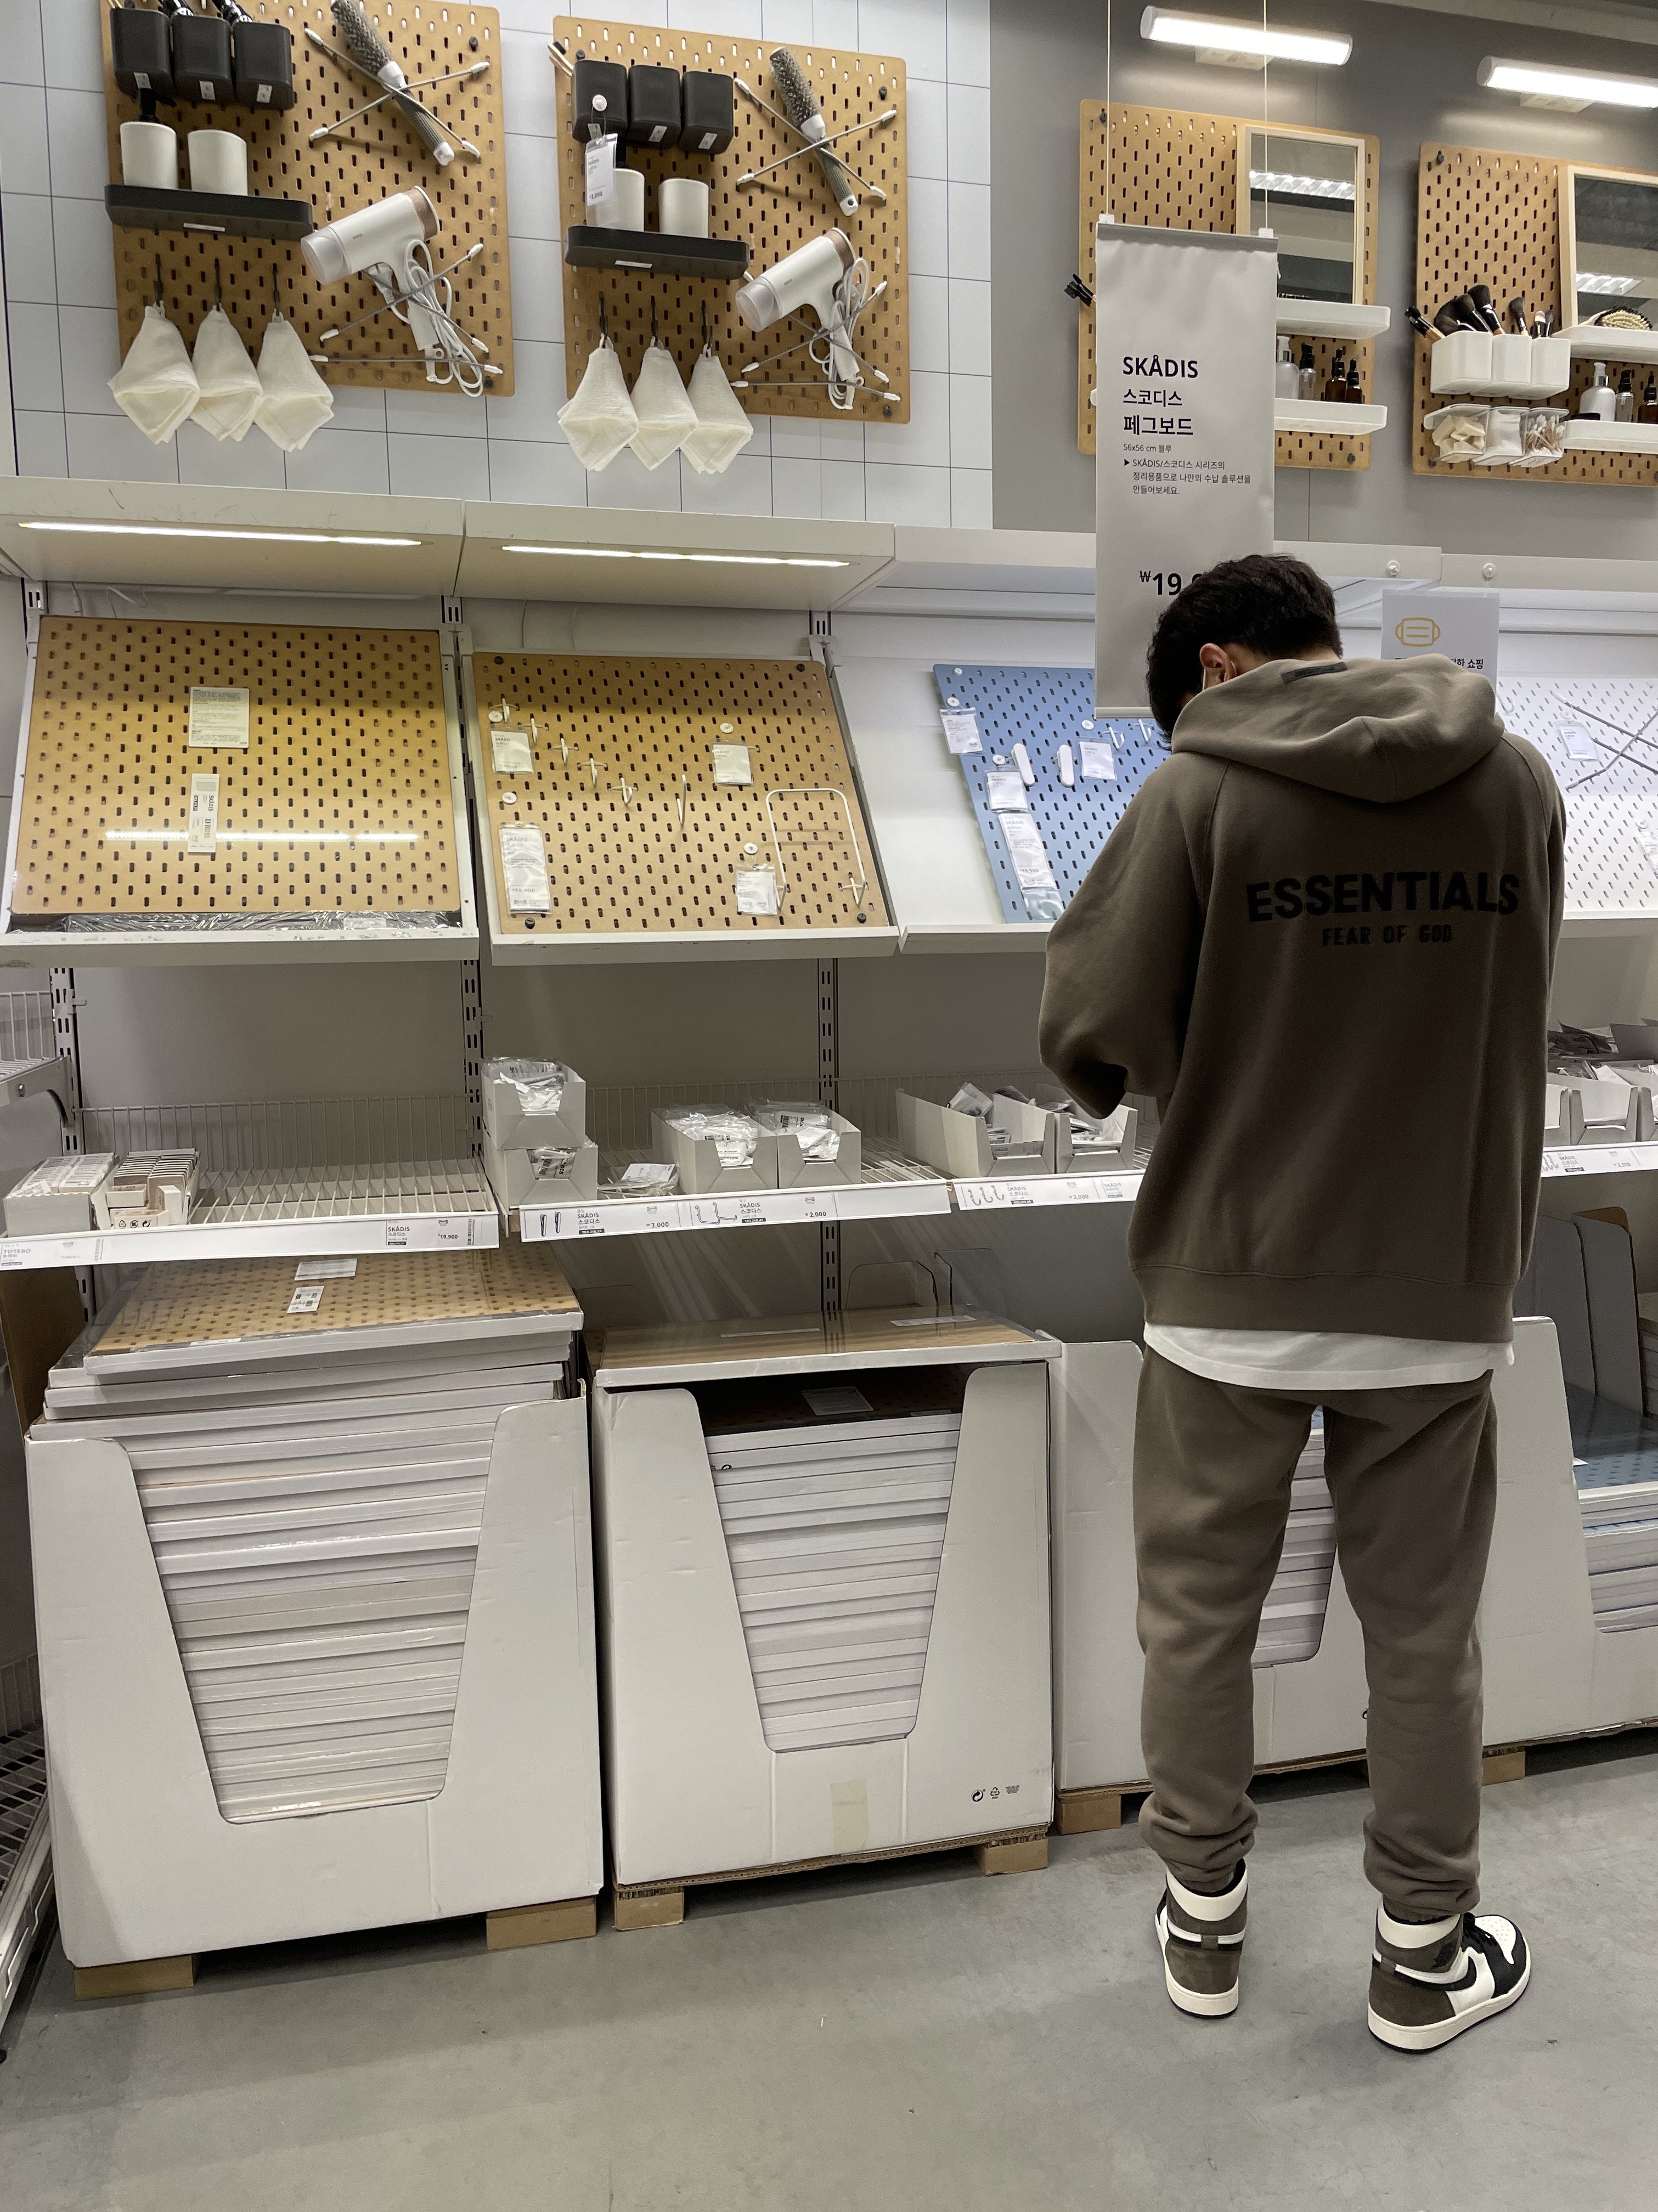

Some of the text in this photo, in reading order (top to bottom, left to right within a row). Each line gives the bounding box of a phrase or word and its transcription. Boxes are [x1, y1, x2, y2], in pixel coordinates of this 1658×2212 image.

[1123, 354, 1198, 379] SKÅDIS
[1123, 388, 1183, 407] 스코디스
[1124, 415, 1193, 435] 페그보드
[1123, 443, 1144, 452] 56x56
[1159, 444, 1172, 453] 블루
[1132, 458, 1225, 470] SKÅDIS/스코디스 시리즈의
[1132, 472, 1251, 484] 정리용품으로 나만의 수납 솔루션을
[1133, 485, 1180, 495] 만들어보세요.
[1467, 658, 1484, 669] 쇼핑
[1247, 871, 1520, 922] ESSENTIALS
[1322, 924, 1454, 946] FEAR OF GOD
